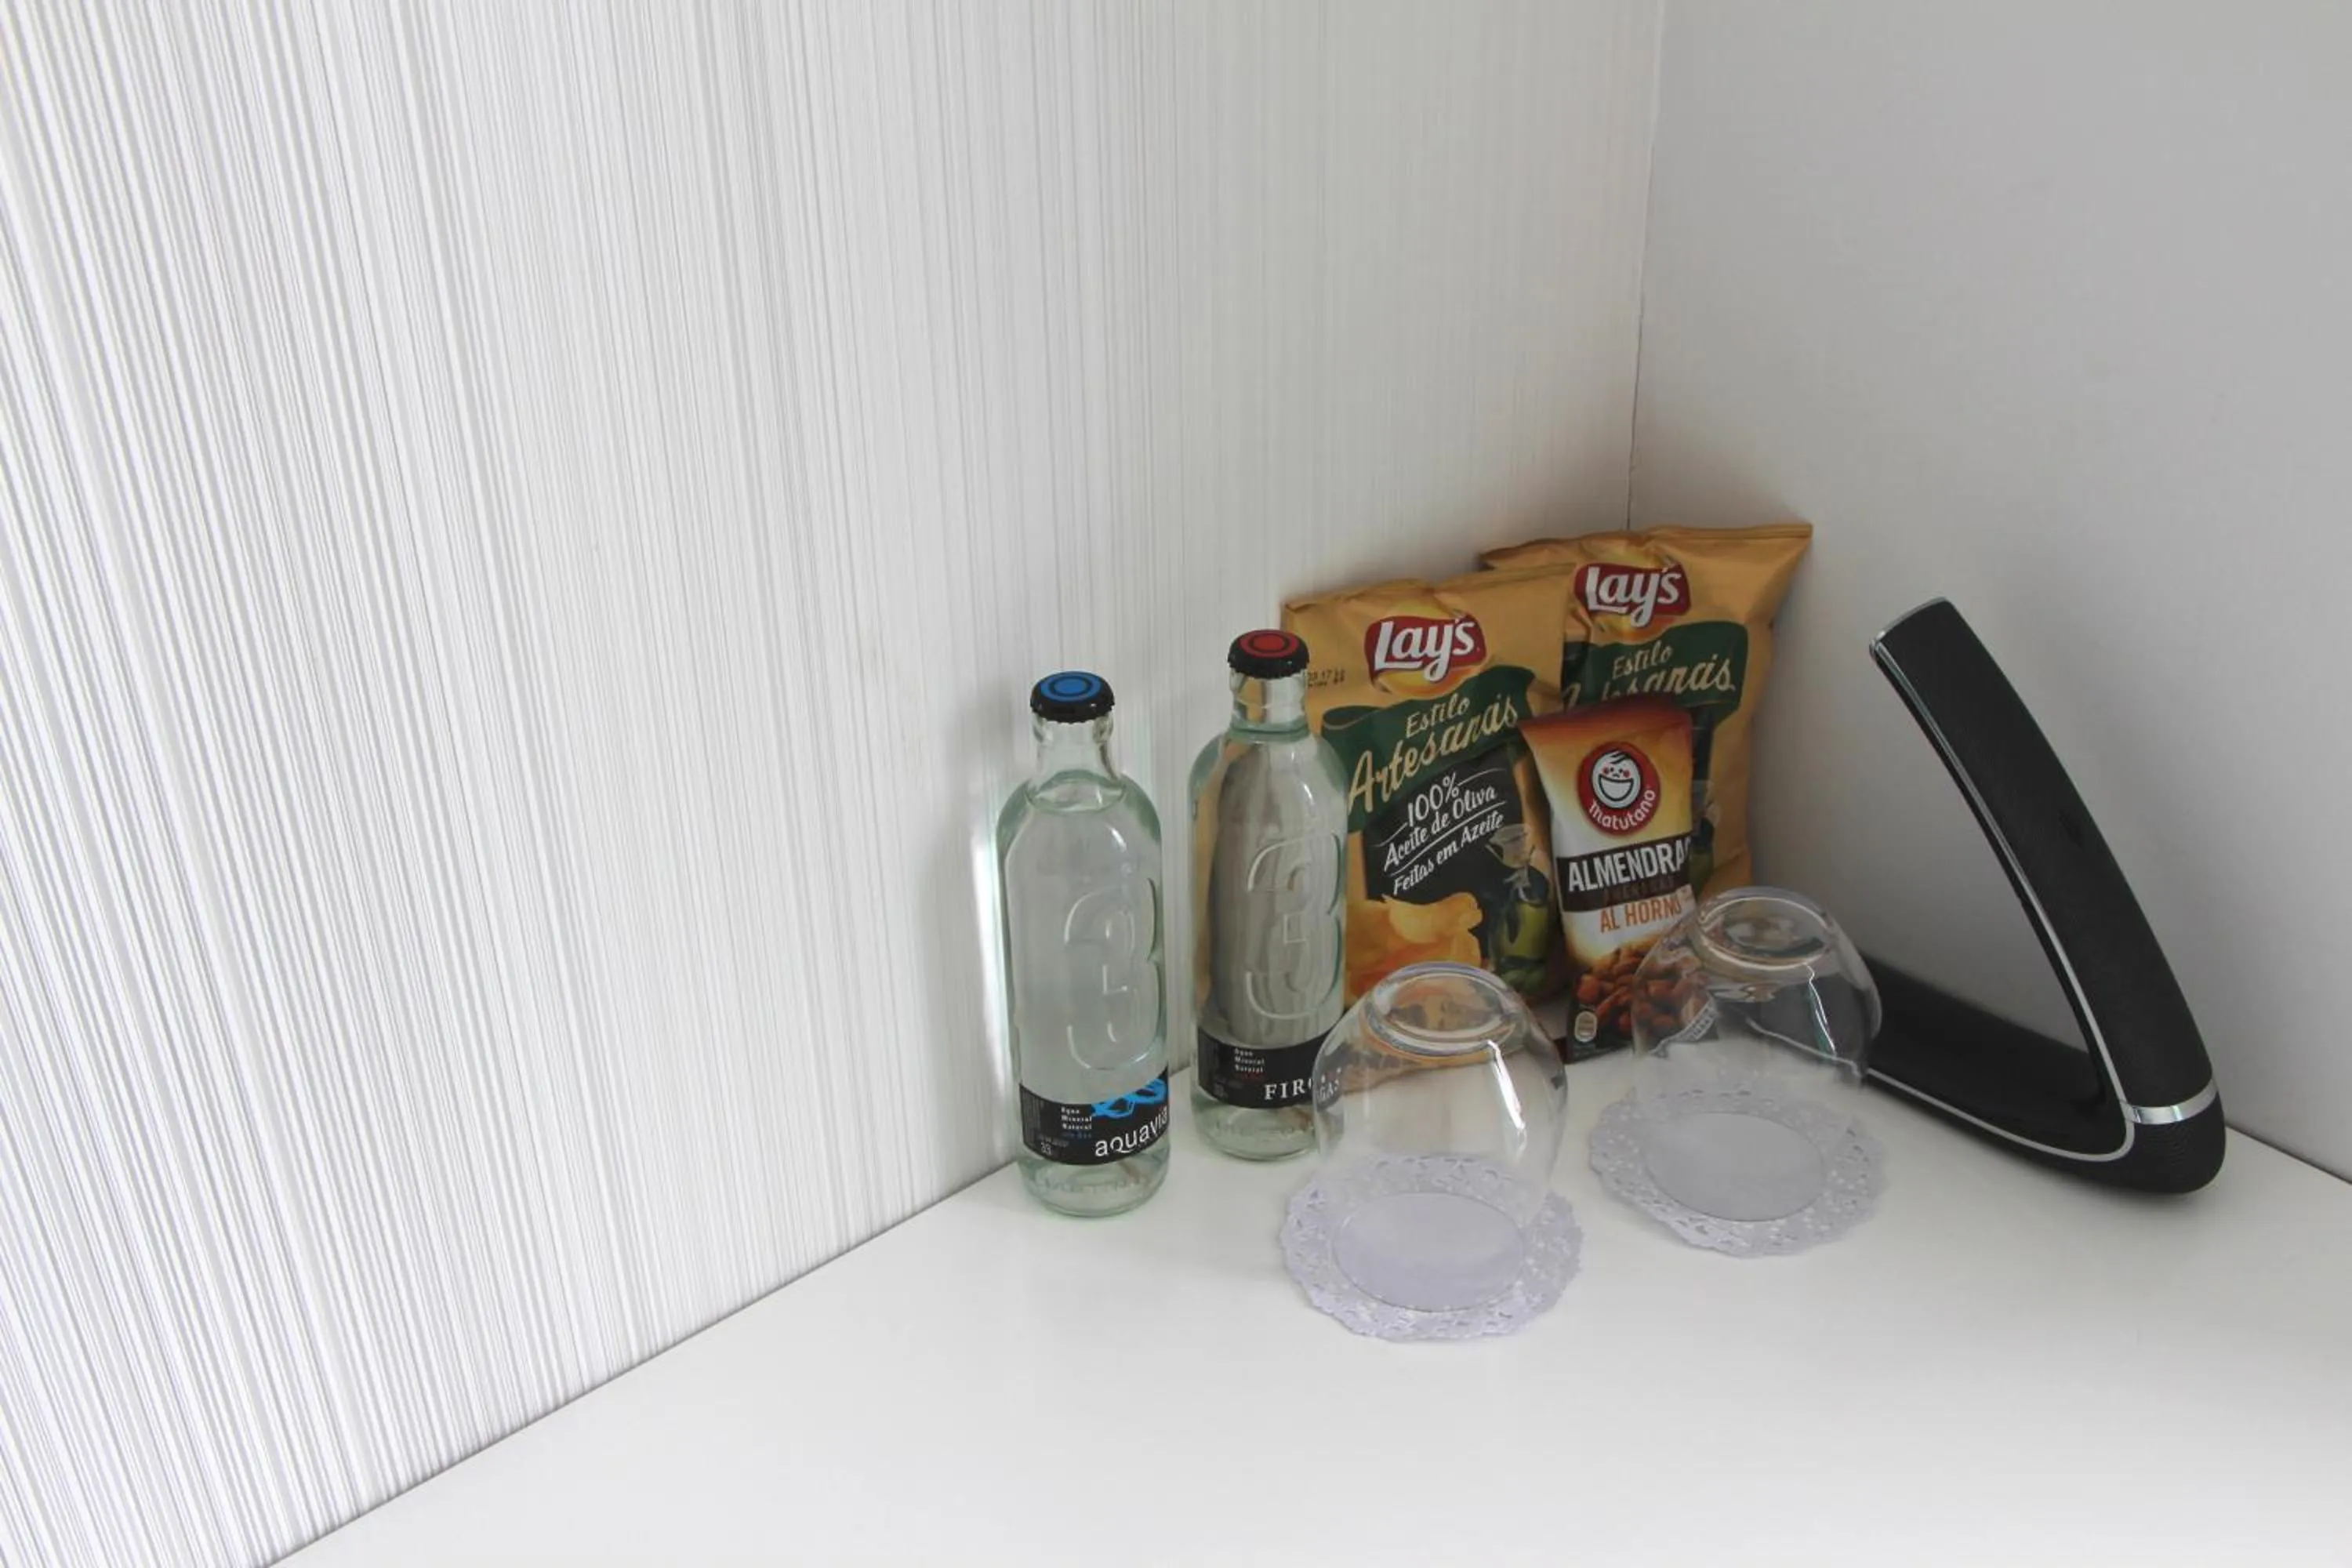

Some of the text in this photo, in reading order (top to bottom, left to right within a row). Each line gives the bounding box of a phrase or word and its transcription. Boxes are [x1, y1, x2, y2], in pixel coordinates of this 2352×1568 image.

[1584, 566, 1682, 626] Lay's
[1374, 618, 1475, 683] Lay's
[1612, 640, 1673, 680] Estilo
[1406, 693, 1470, 739] Estilo
[1348, 694, 1518, 815] Artesanais
[1408, 771, 1459, 826] 100%
[1384, 786, 1497, 872] Aceite de Oliva
[1393, 811, 1504, 896] Feitas em Azeite
[1600, 909, 1620, 933] AL
[1094, 1105, 1168, 1157] aquavia
